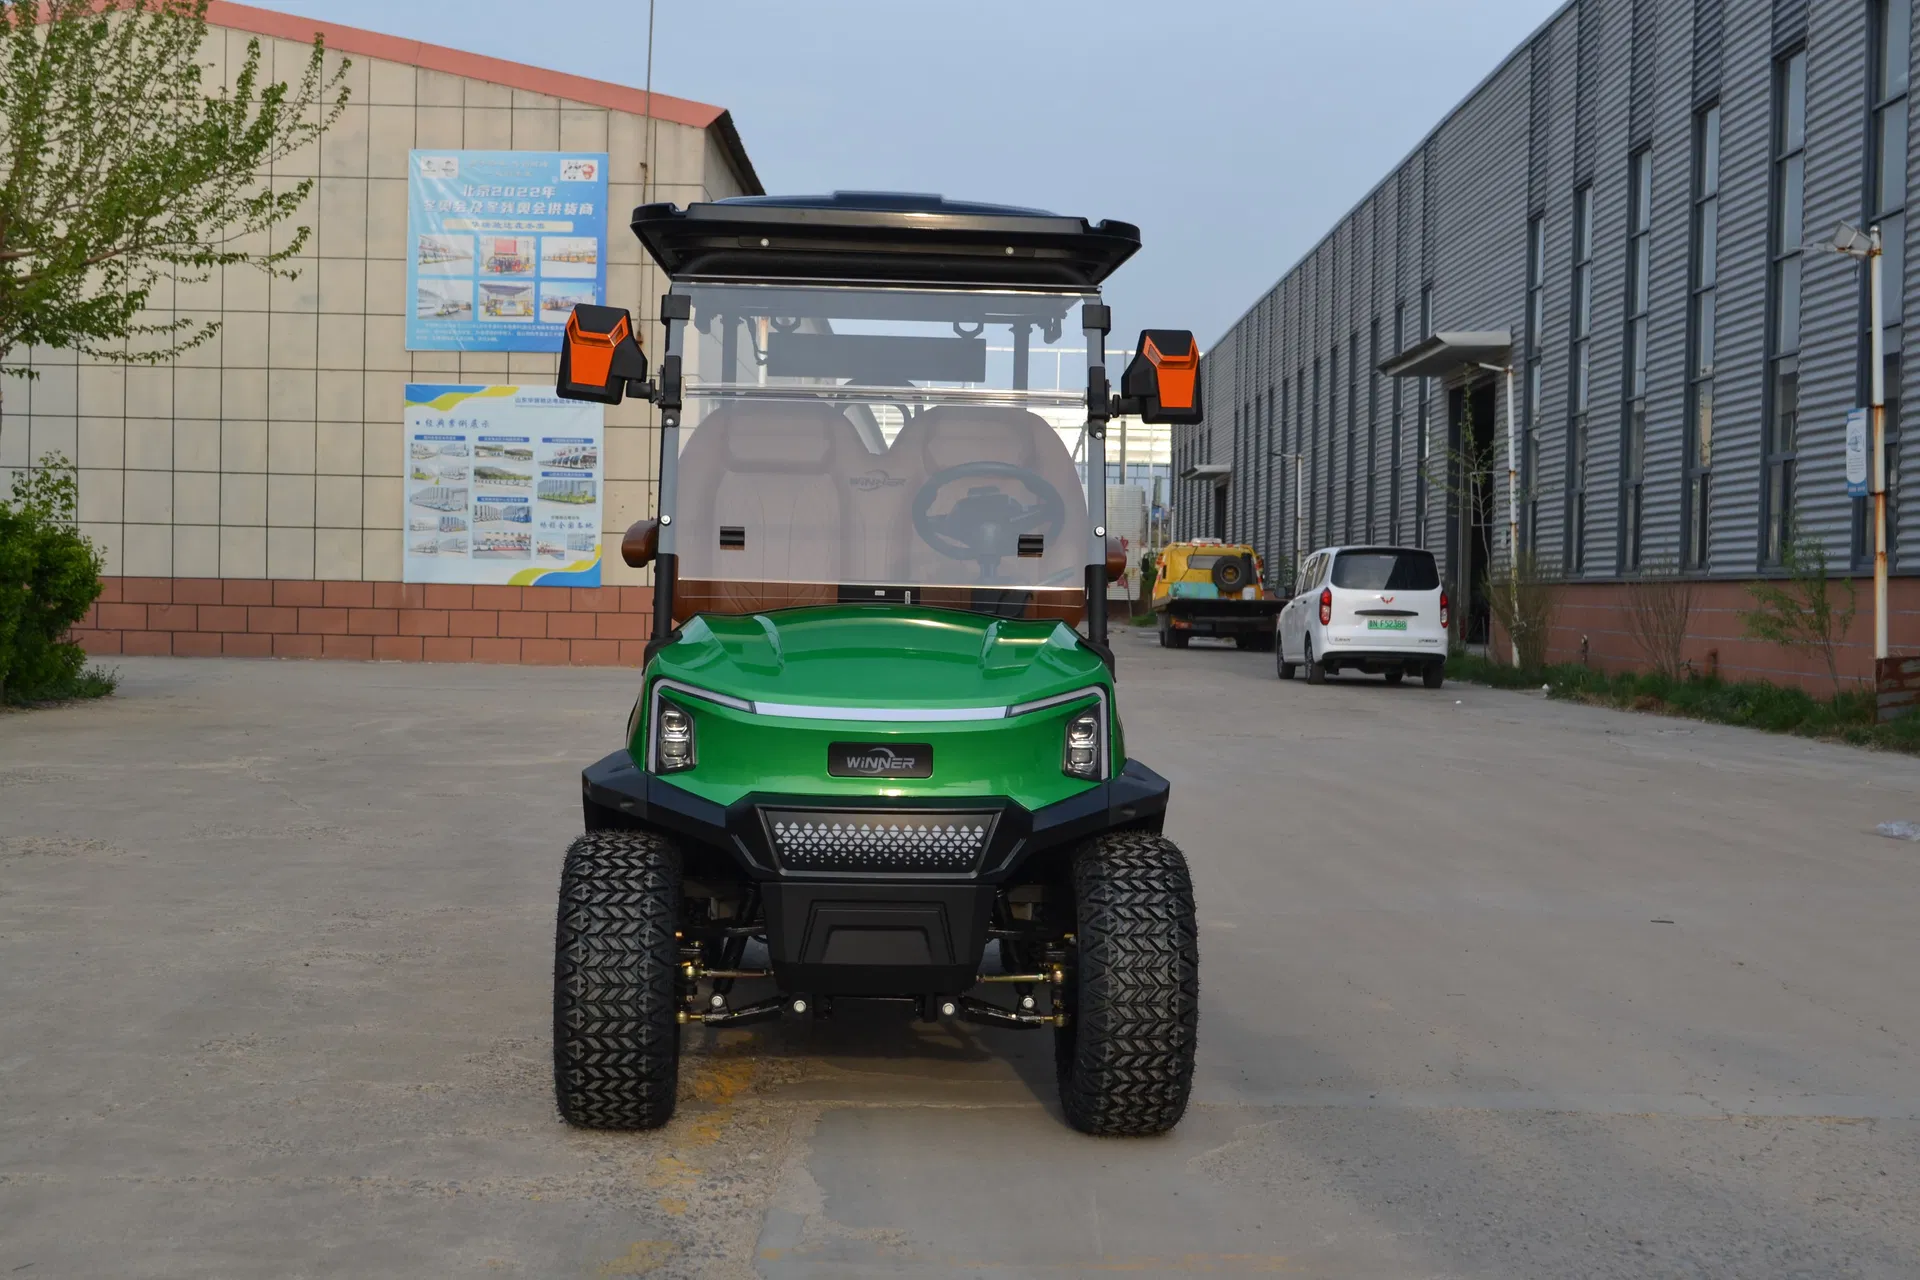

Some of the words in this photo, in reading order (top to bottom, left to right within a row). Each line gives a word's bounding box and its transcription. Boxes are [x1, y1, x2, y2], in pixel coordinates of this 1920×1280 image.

[462, 184, 557, 199] 北京2022年
[423, 200, 594, 216] 冬奥会及冬残奥会供货商
